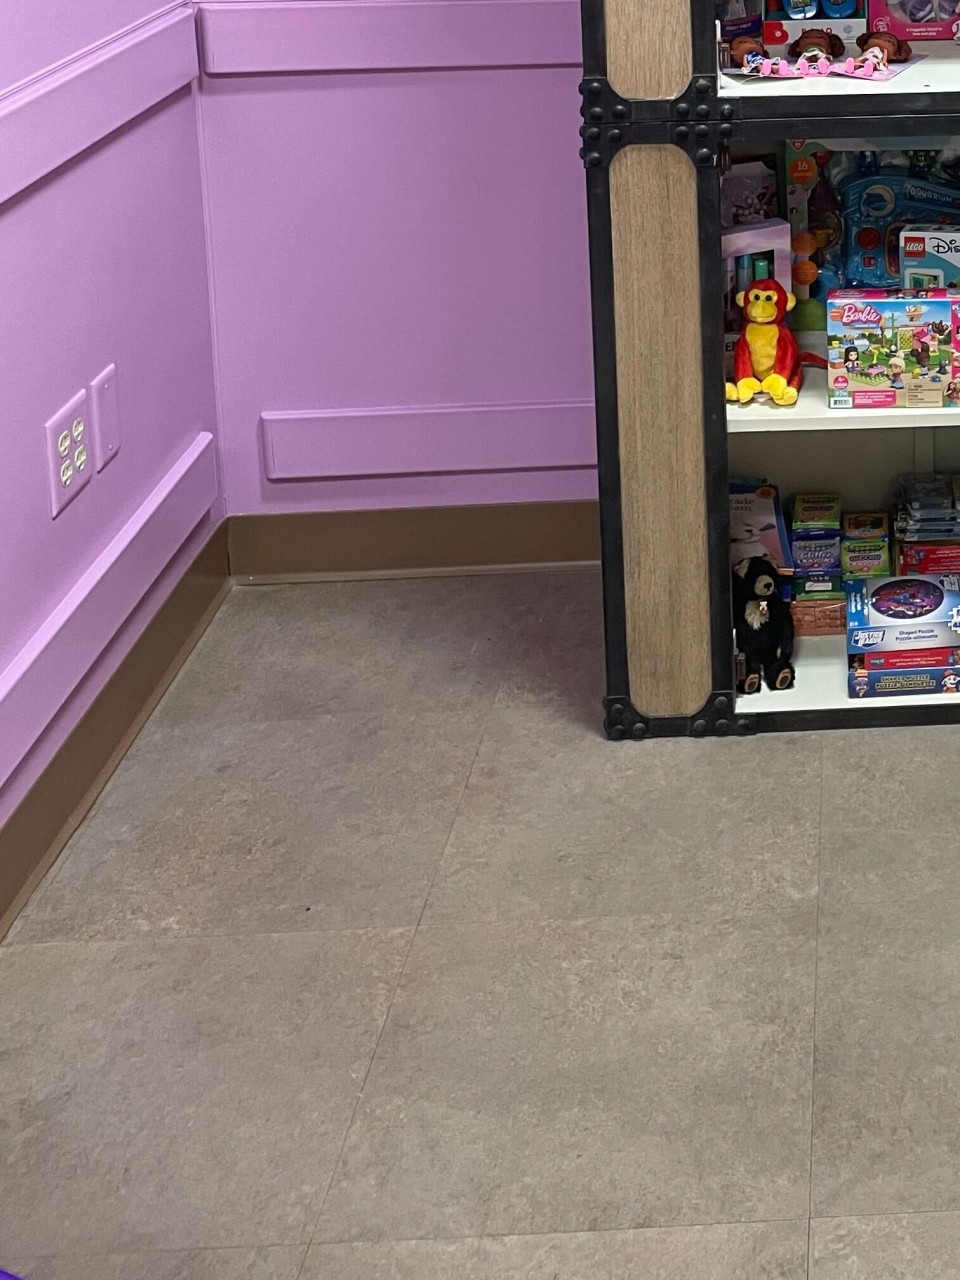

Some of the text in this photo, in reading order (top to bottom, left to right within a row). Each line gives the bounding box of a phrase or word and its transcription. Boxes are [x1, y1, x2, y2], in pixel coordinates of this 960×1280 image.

[798, 160, 808, 171] 16
[906, 243, 924, 251] LEGO
[842, 304, 881, 323] Barbie
[854, 630, 883, 640] JUSTICE
